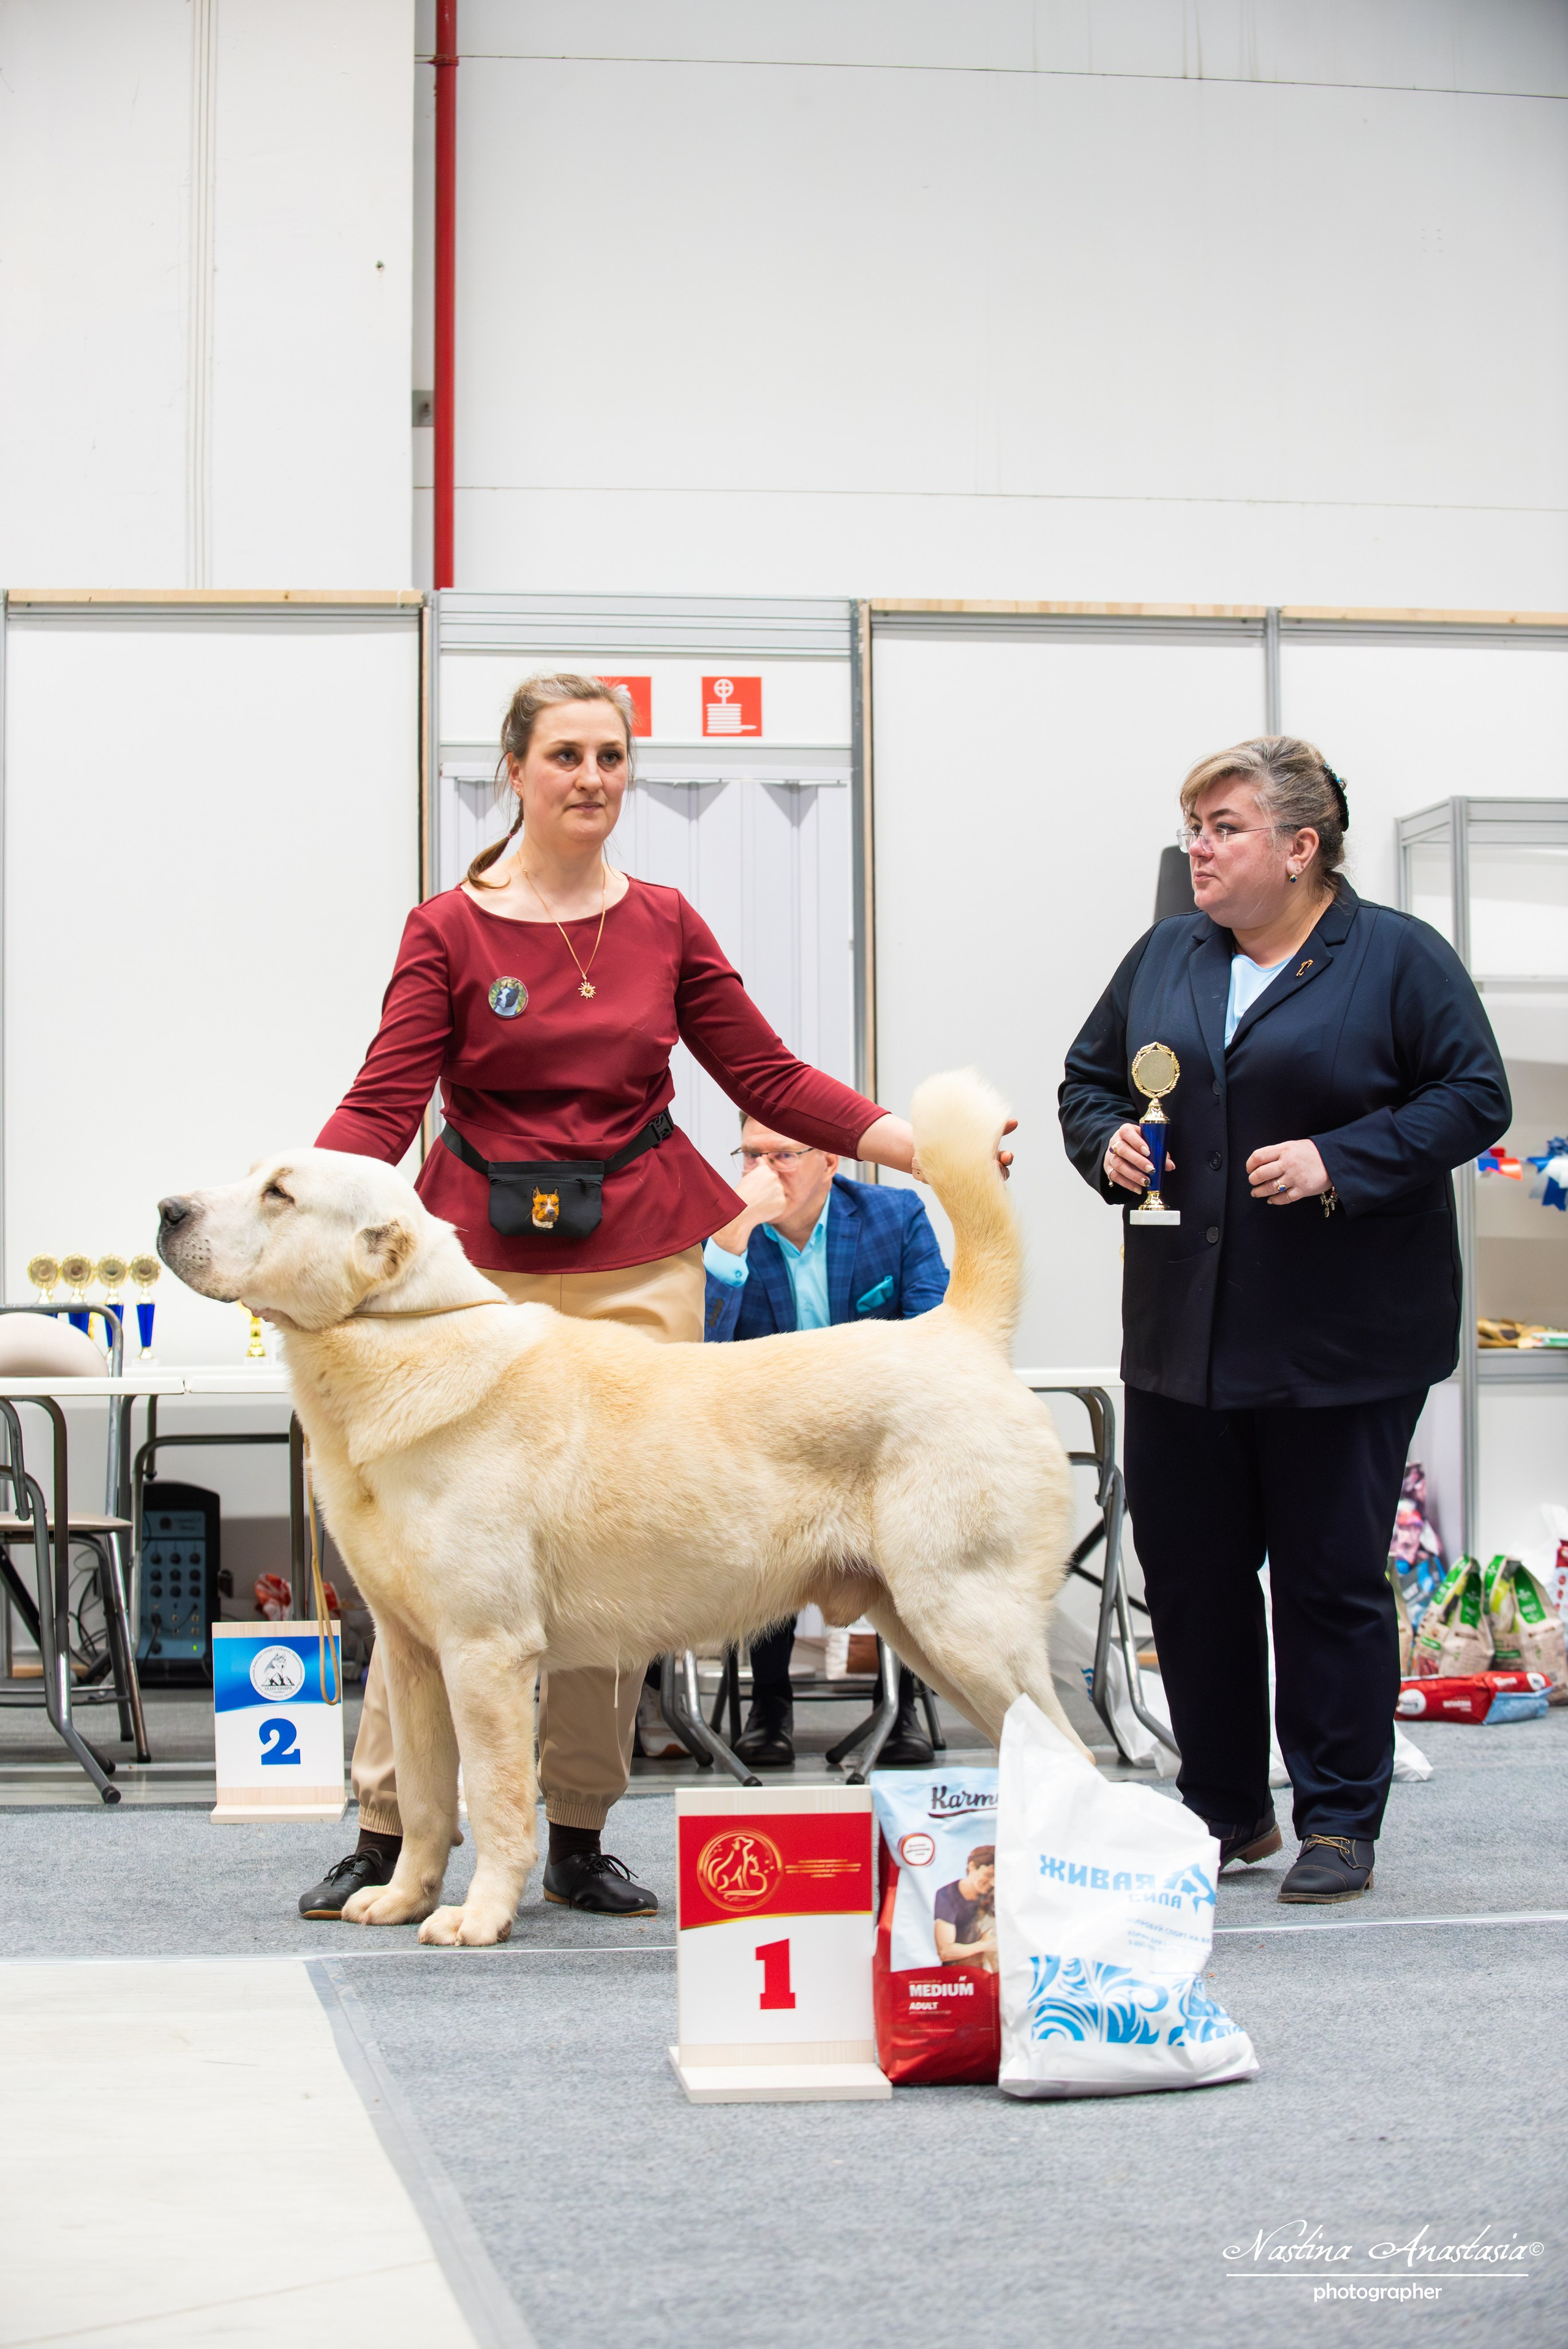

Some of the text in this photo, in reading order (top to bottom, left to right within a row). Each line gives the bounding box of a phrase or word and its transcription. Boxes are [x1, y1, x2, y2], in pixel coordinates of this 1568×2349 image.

[258, 1718, 301, 1765] 2
[932, 1785, 998, 1809] Karm
[1040, 1855, 1155, 1890] ЖИВАЯ
[1129, 1892, 1182, 1909] СИЛА
[755, 1938, 796, 2010] 1
[909, 1983, 974, 1997] MEDIUM
[908, 2002, 938, 2010] ADULT
